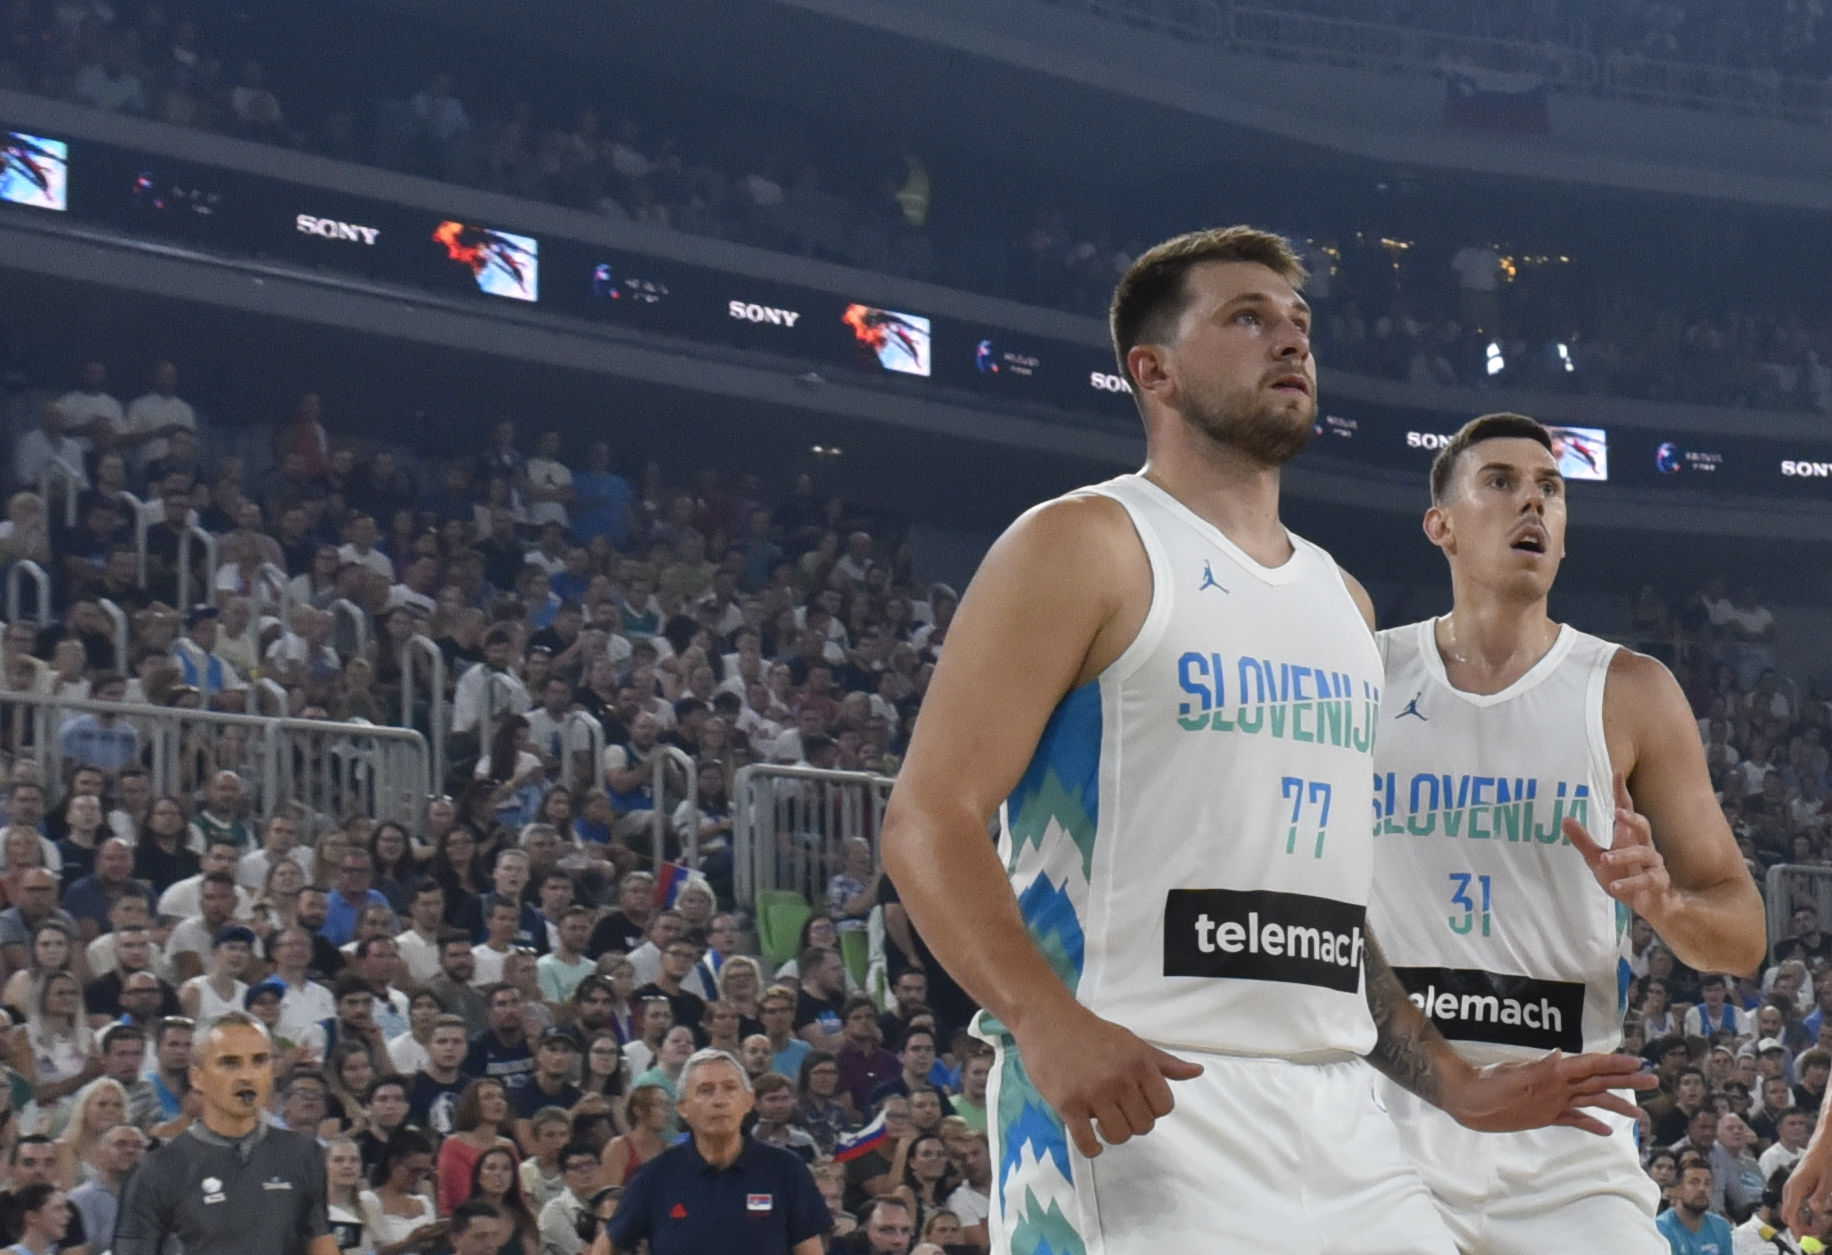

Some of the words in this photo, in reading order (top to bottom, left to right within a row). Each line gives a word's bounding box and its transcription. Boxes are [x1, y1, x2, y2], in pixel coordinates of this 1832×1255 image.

[297, 214, 380, 244] SONY
[729, 300, 800, 327] SONY
[1090, 371, 1133, 394] SON
[1406, 431, 1454, 450] SON
[1281, 776, 1332, 860] 77
[1449, 873, 1492, 937] 31
[1408, 985, 1563, 1033] elemach
